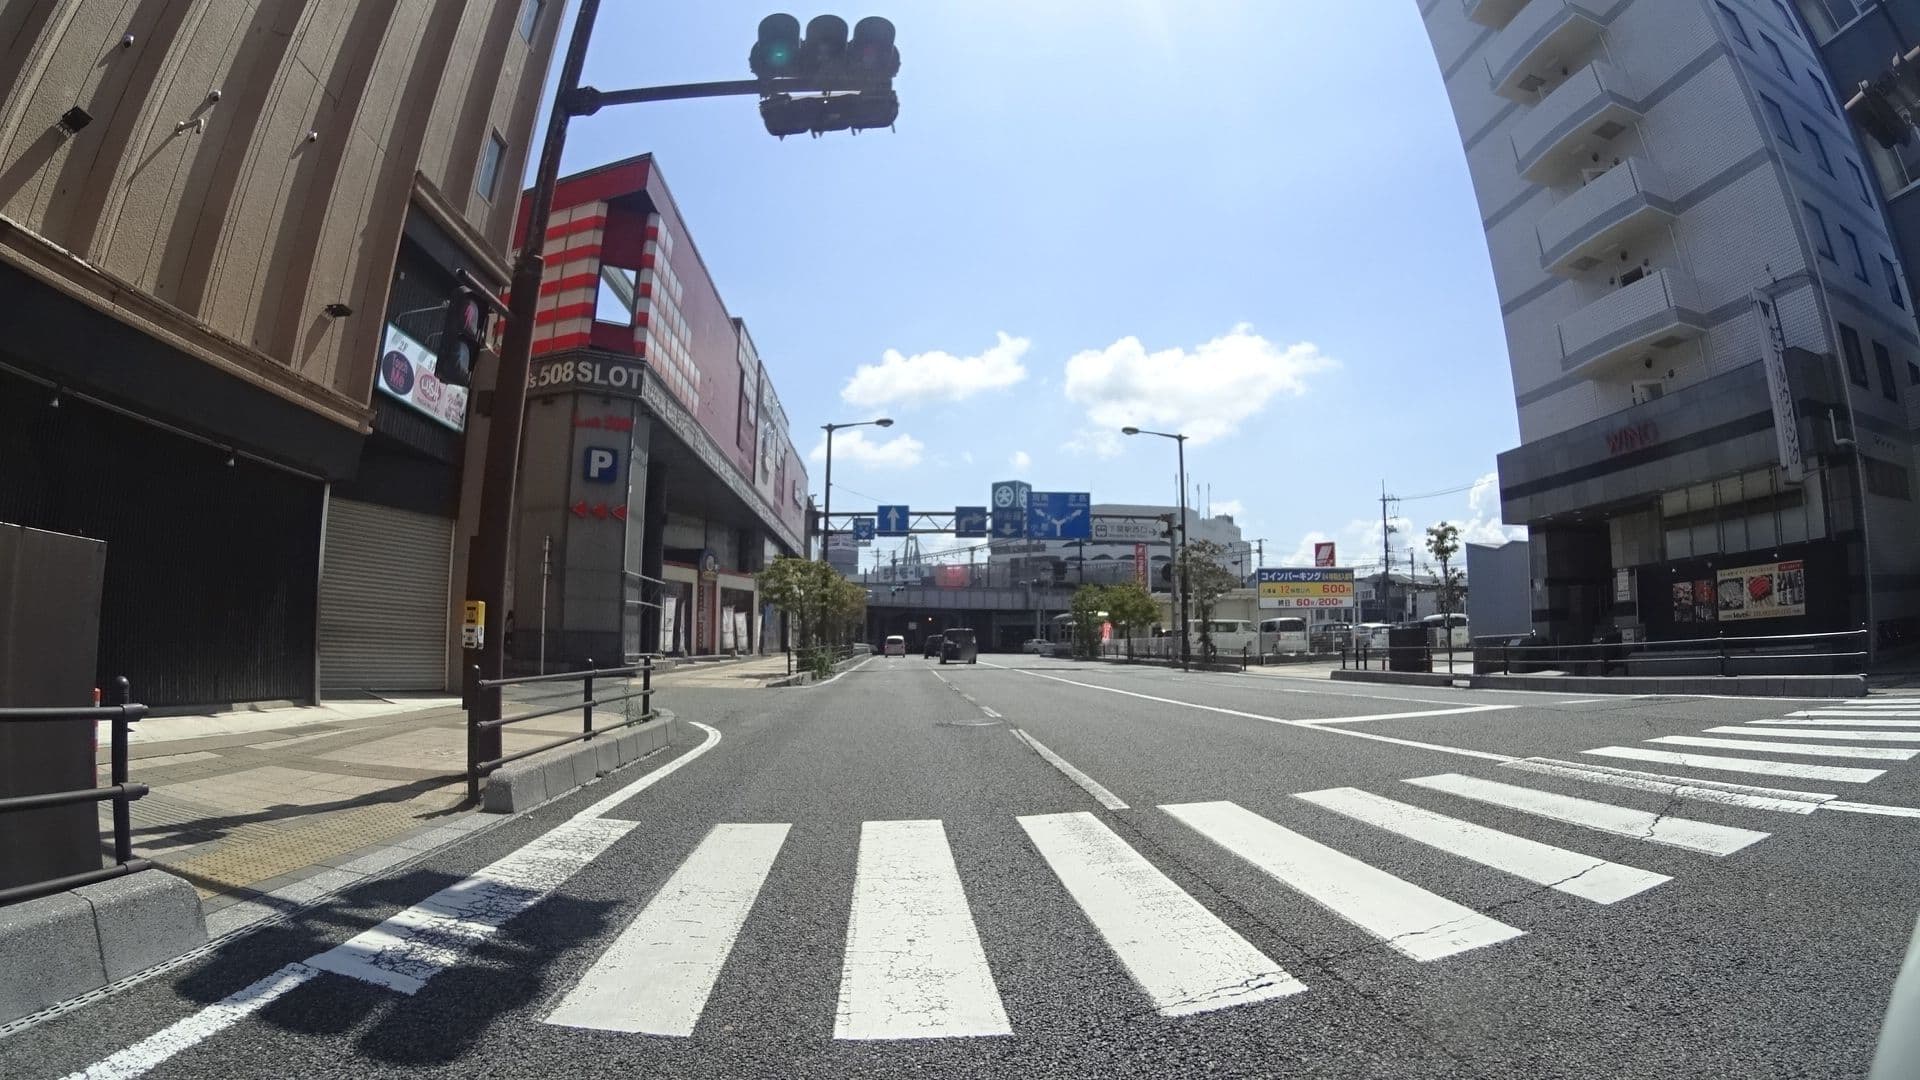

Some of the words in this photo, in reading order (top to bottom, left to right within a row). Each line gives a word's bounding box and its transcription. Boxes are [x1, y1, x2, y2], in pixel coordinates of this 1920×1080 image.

[538, 361, 575, 387] 508
[576, 361, 643, 390] SLOT
[590, 450, 613, 477] P
[1261, 571, 1321, 581] コインパーキング
